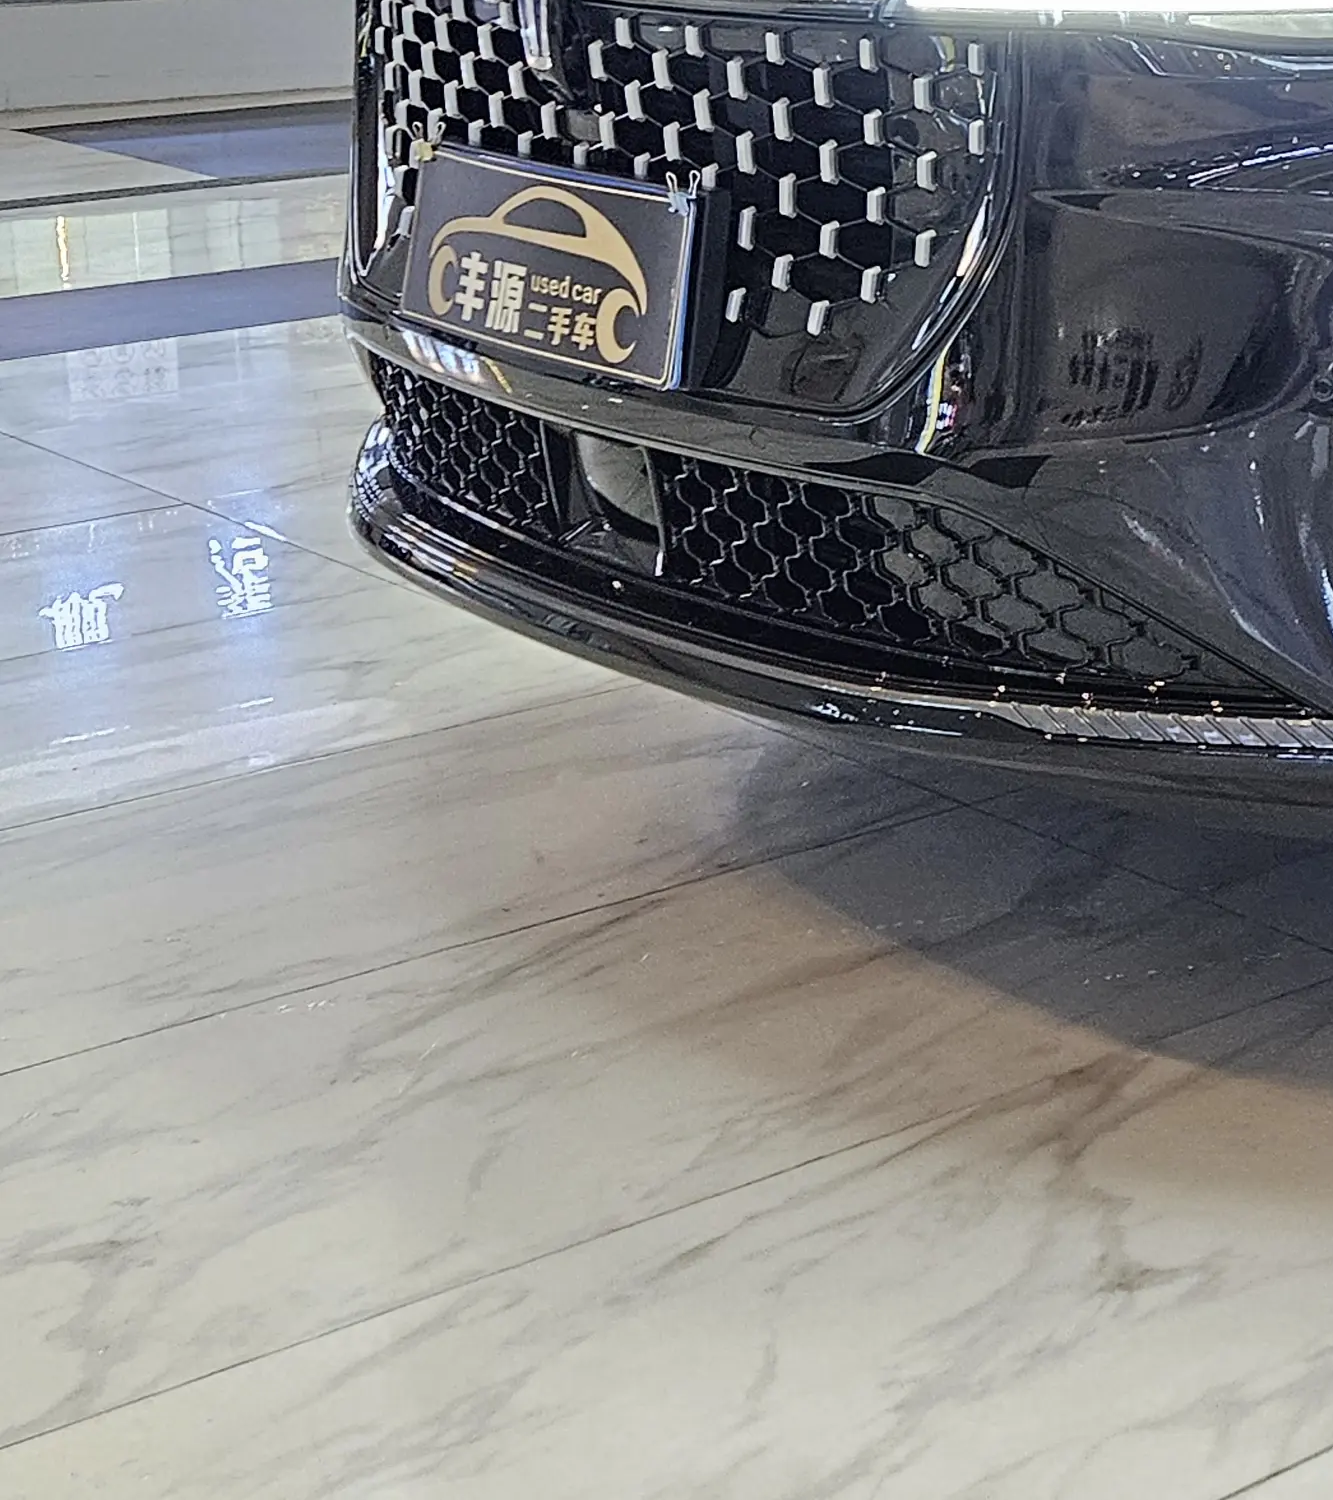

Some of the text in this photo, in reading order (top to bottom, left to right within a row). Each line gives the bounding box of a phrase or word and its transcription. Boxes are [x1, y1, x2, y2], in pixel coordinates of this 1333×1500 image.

[455, 251, 528, 333] 丰源
[529, 274, 603, 305] used car
[523, 302, 597, 351] 二手车
